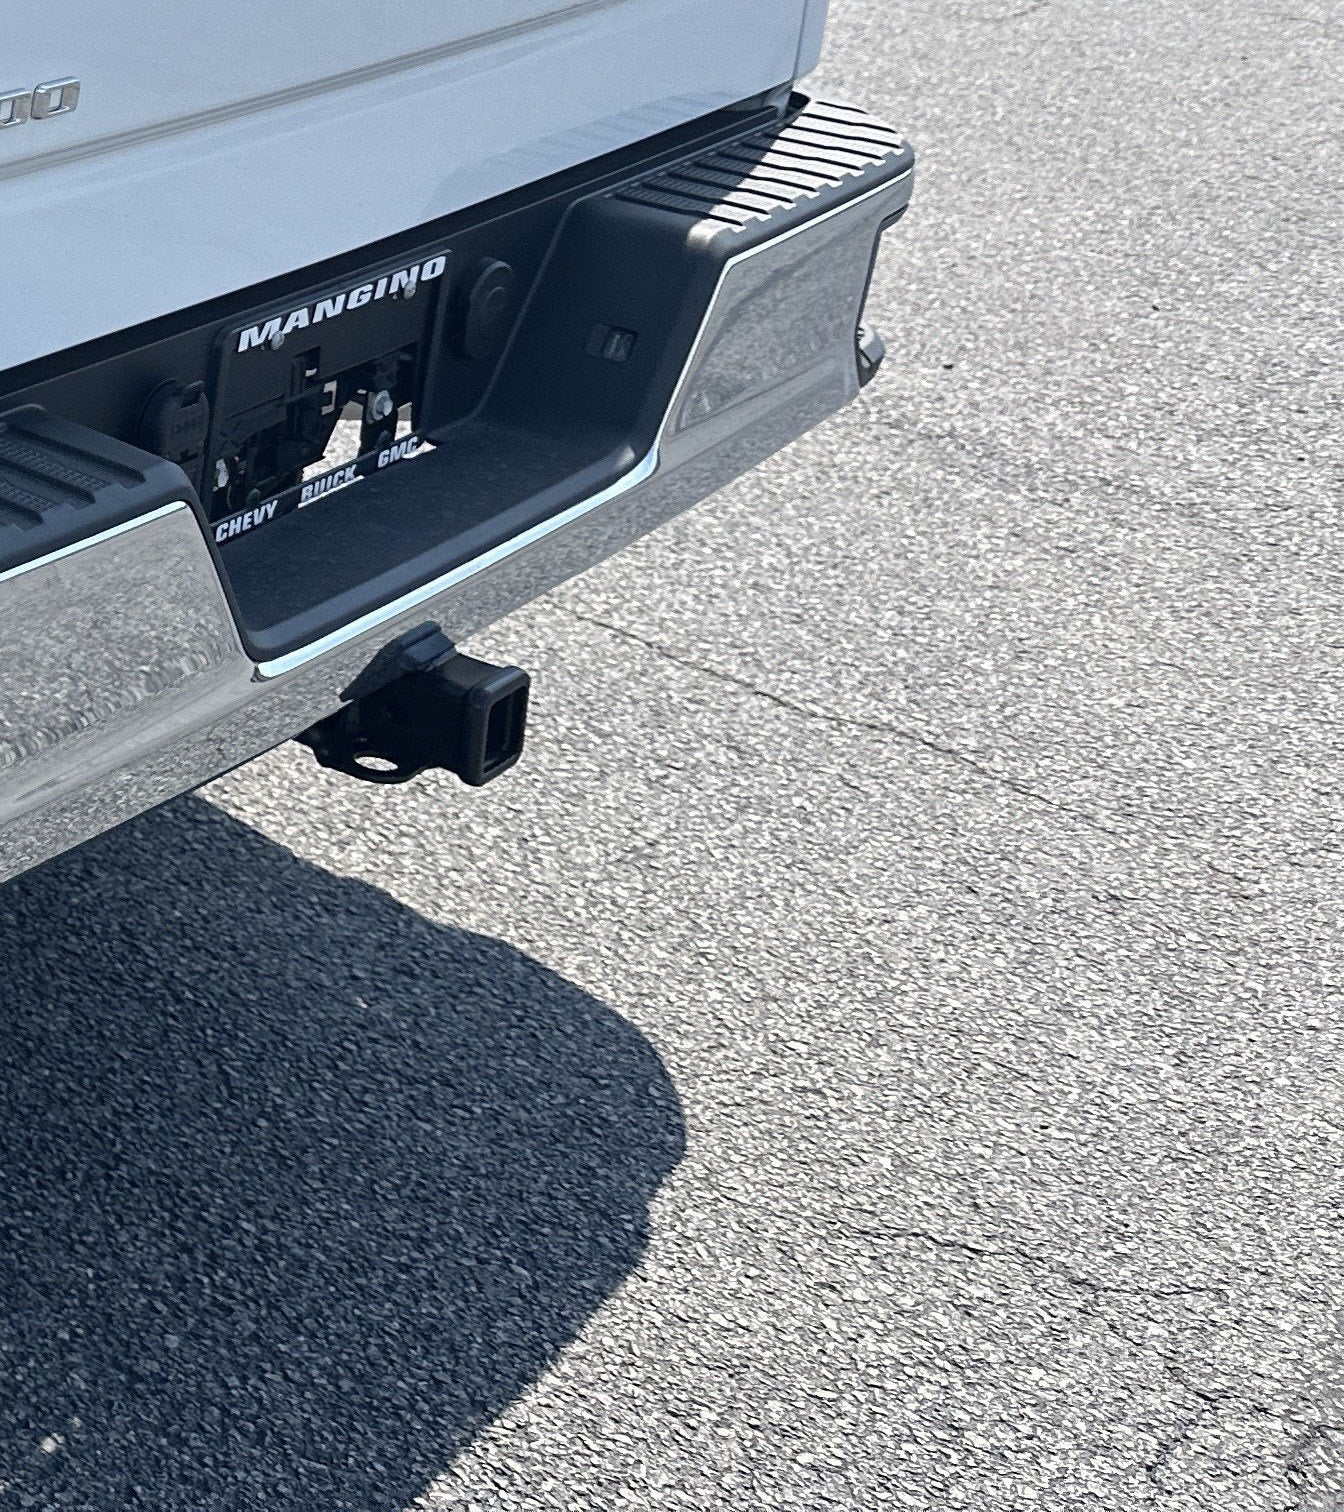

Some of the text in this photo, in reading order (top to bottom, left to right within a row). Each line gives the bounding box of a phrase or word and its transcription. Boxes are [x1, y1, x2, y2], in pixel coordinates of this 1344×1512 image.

[237, 256, 447, 353] MANGINO
[215, 435, 419, 543] CHEVY BUICK GMC
